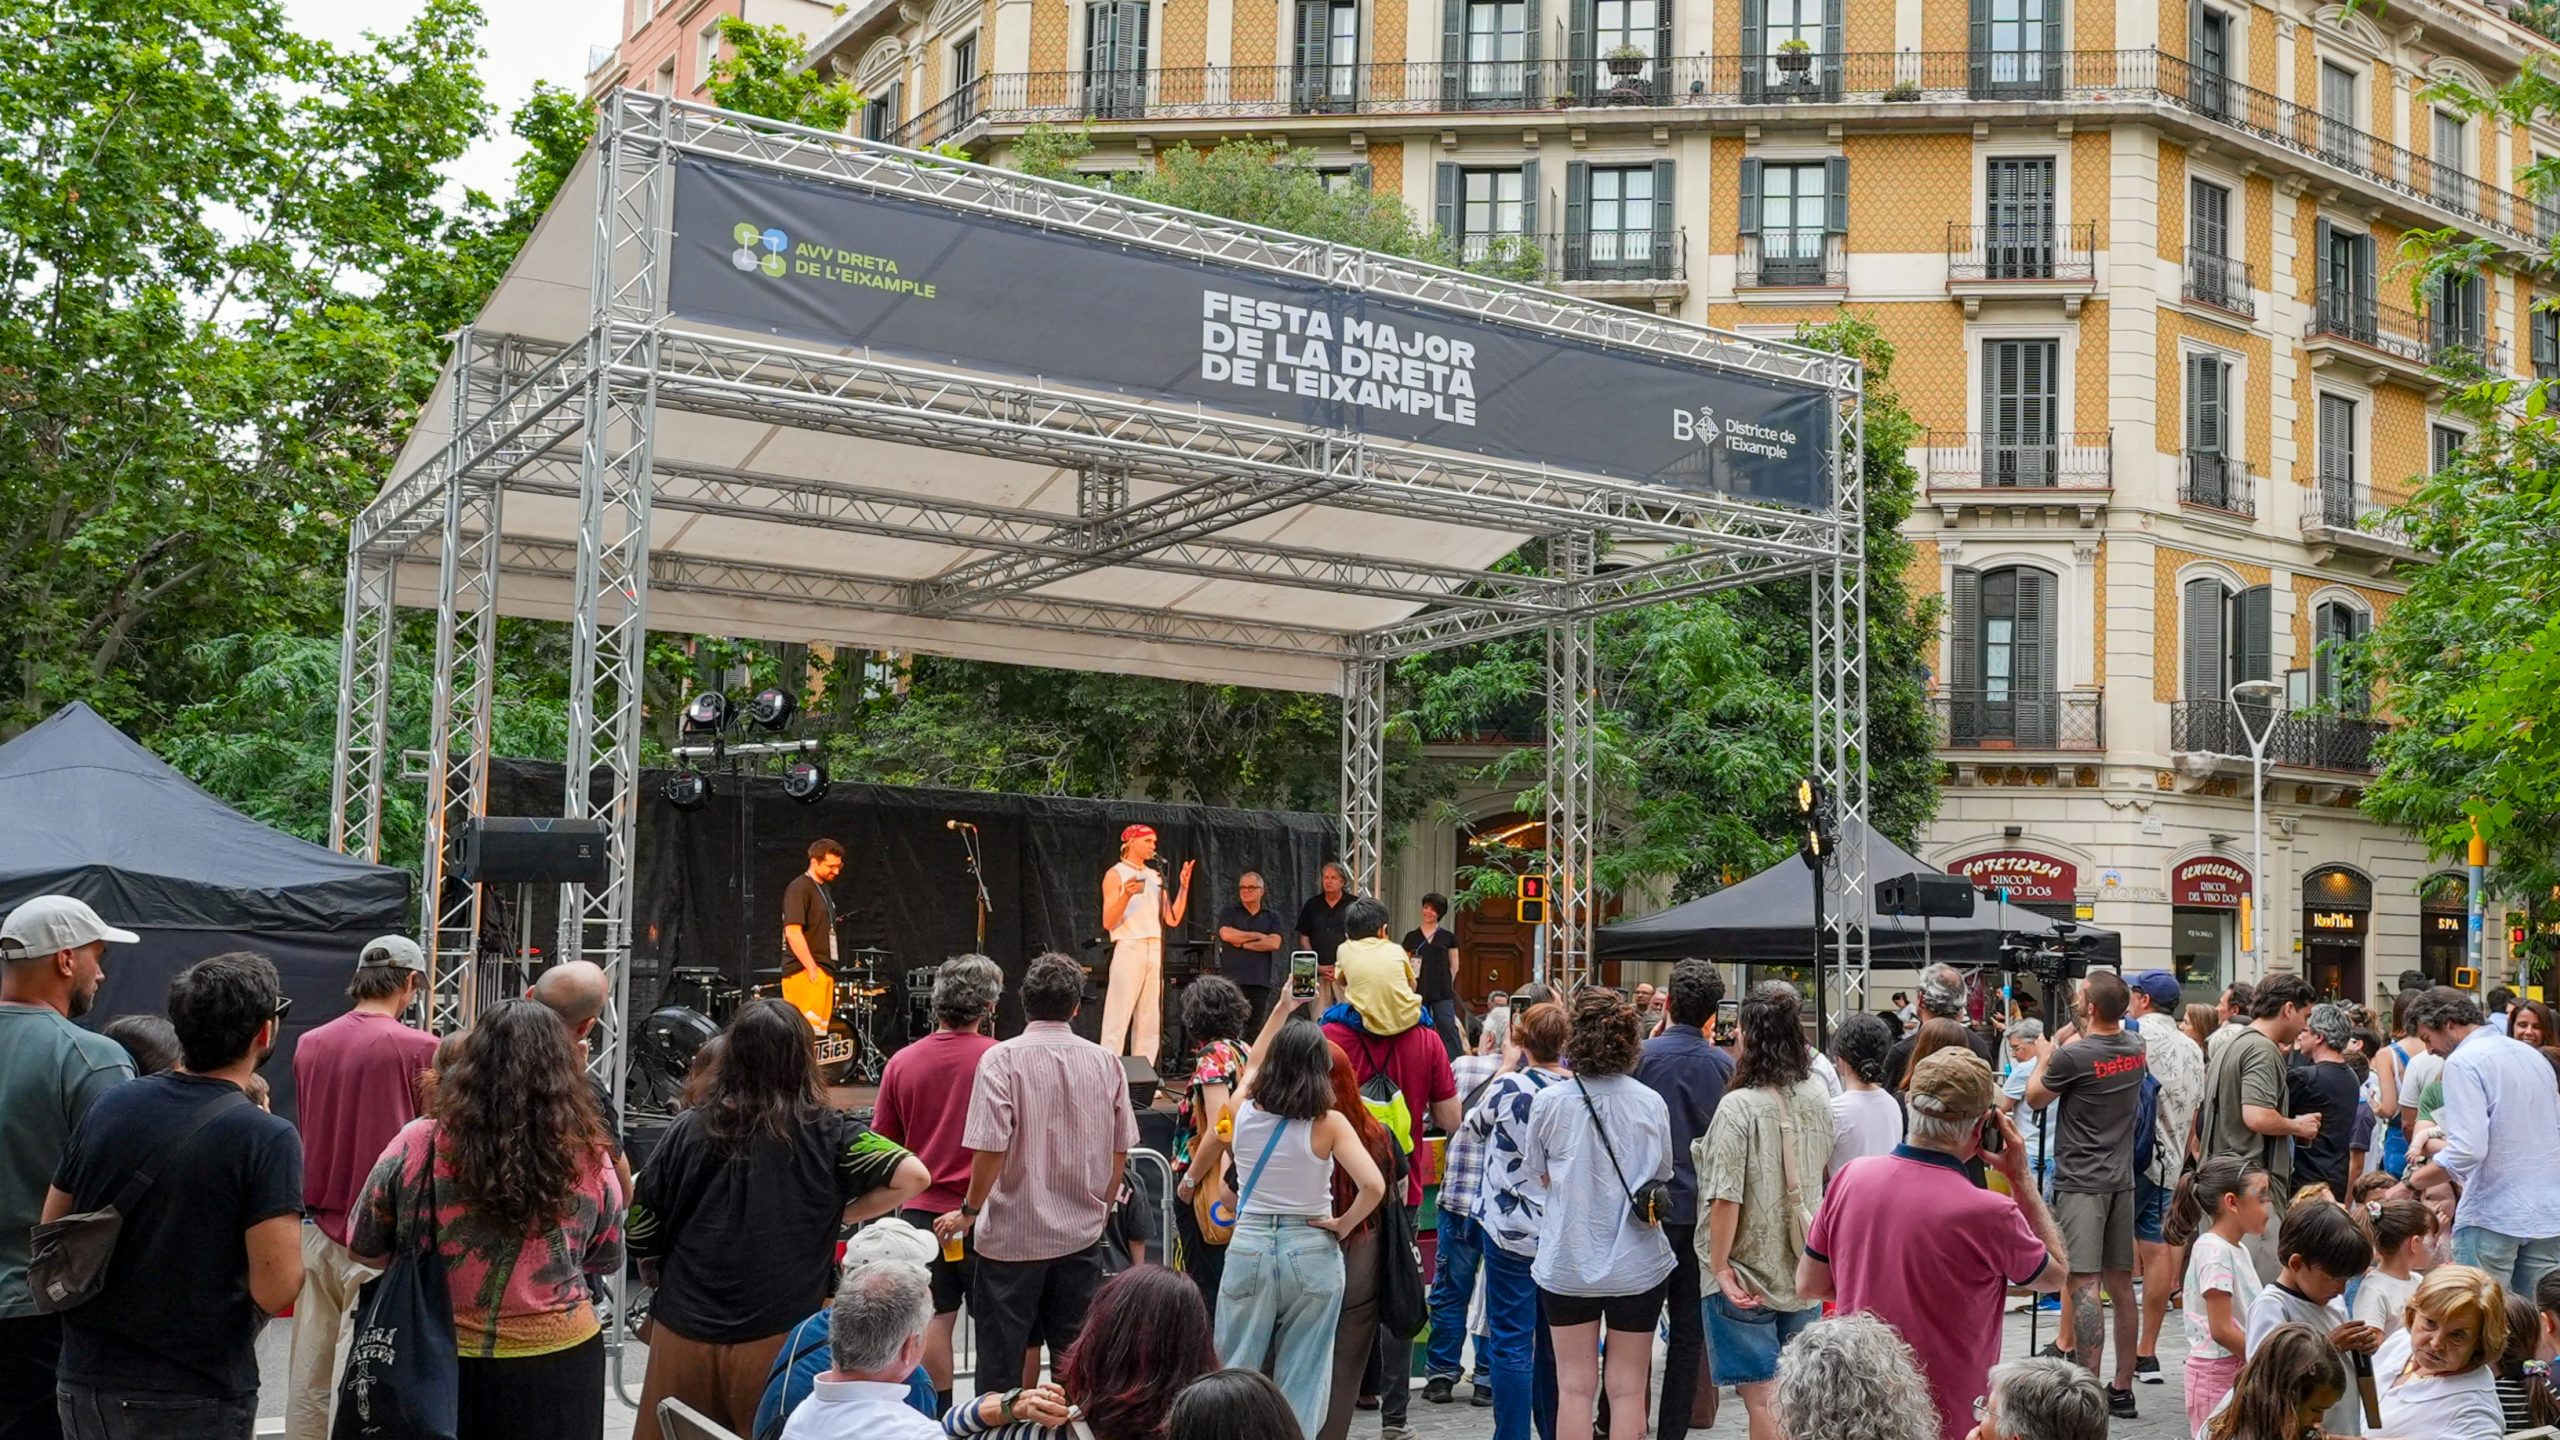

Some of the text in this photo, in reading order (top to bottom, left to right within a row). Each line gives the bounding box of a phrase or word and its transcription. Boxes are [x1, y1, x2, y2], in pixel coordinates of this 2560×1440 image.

[795, 242, 898, 274] AVV DRETA
[795, 260, 820, 278] DE
[1203, 290, 1476, 369] FESTA MAJOR
[1202, 320, 1475, 399] DE LA DRETA
[1202, 352, 1476, 426] DE L'EIXAMPLE
[1673, 408, 1694, 441] B
[1725, 418, 1796, 444] Districte de
[1725, 435, 1788, 459] l'Eixample
[1962, 857, 2062, 878] CAFETERIA
[2181, 863, 2244, 884] CERVECERIA
[1990, 875, 2032, 885] RINCON
[2027, 886, 2052, 897] DOS
[2222, 893, 2238, 903] DOS
[2438, 917, 2459, 930] SPA
